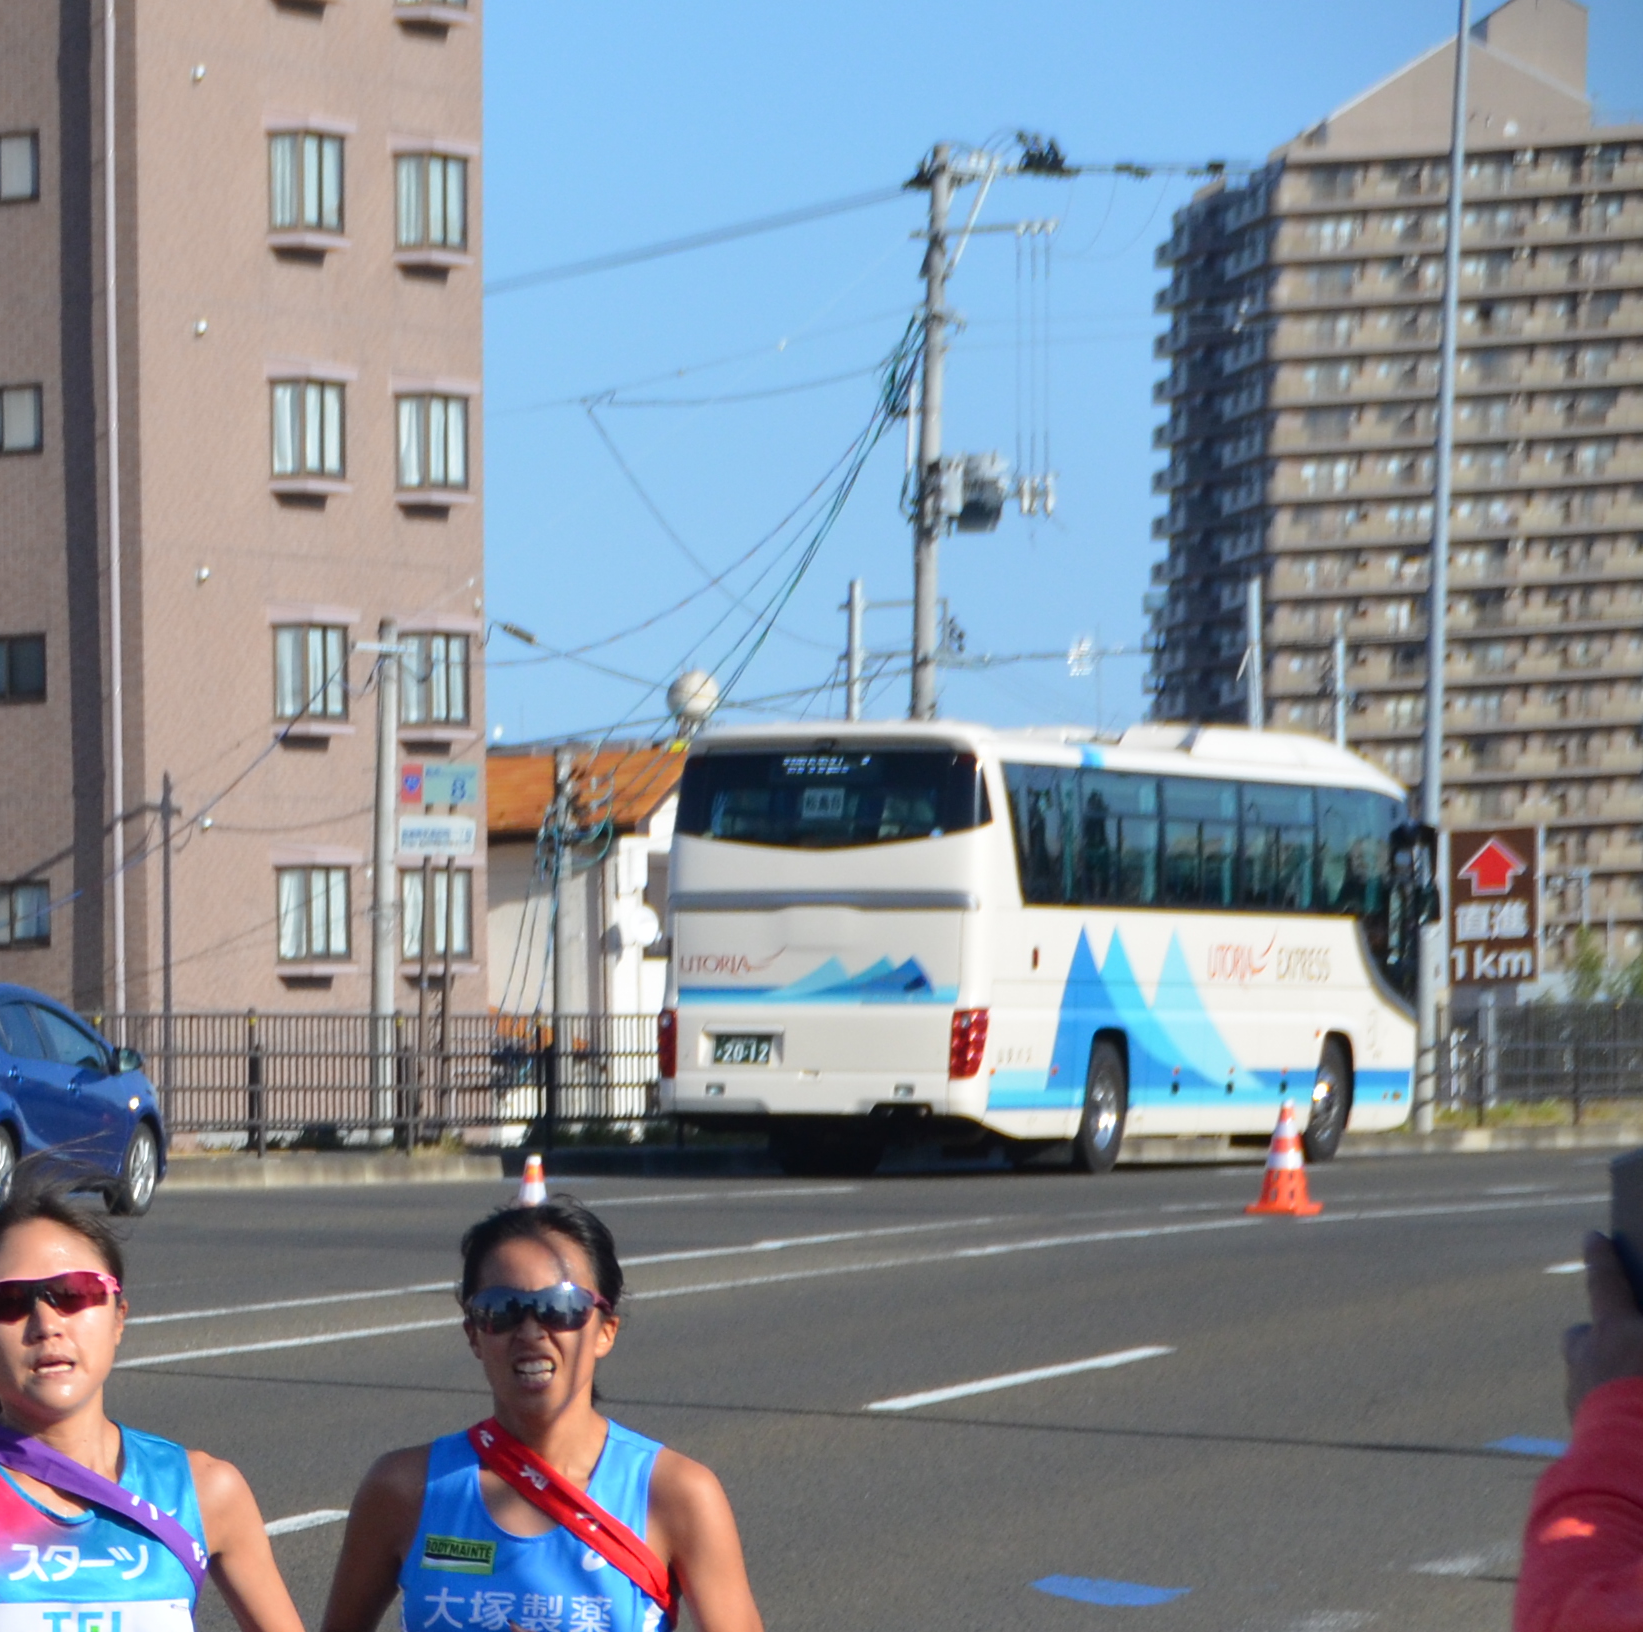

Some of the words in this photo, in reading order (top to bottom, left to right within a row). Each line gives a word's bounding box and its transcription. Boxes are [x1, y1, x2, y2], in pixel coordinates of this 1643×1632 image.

[1455, 901, 1530, 942] 直進
[8, 1543, 149, 1582] スターツ
